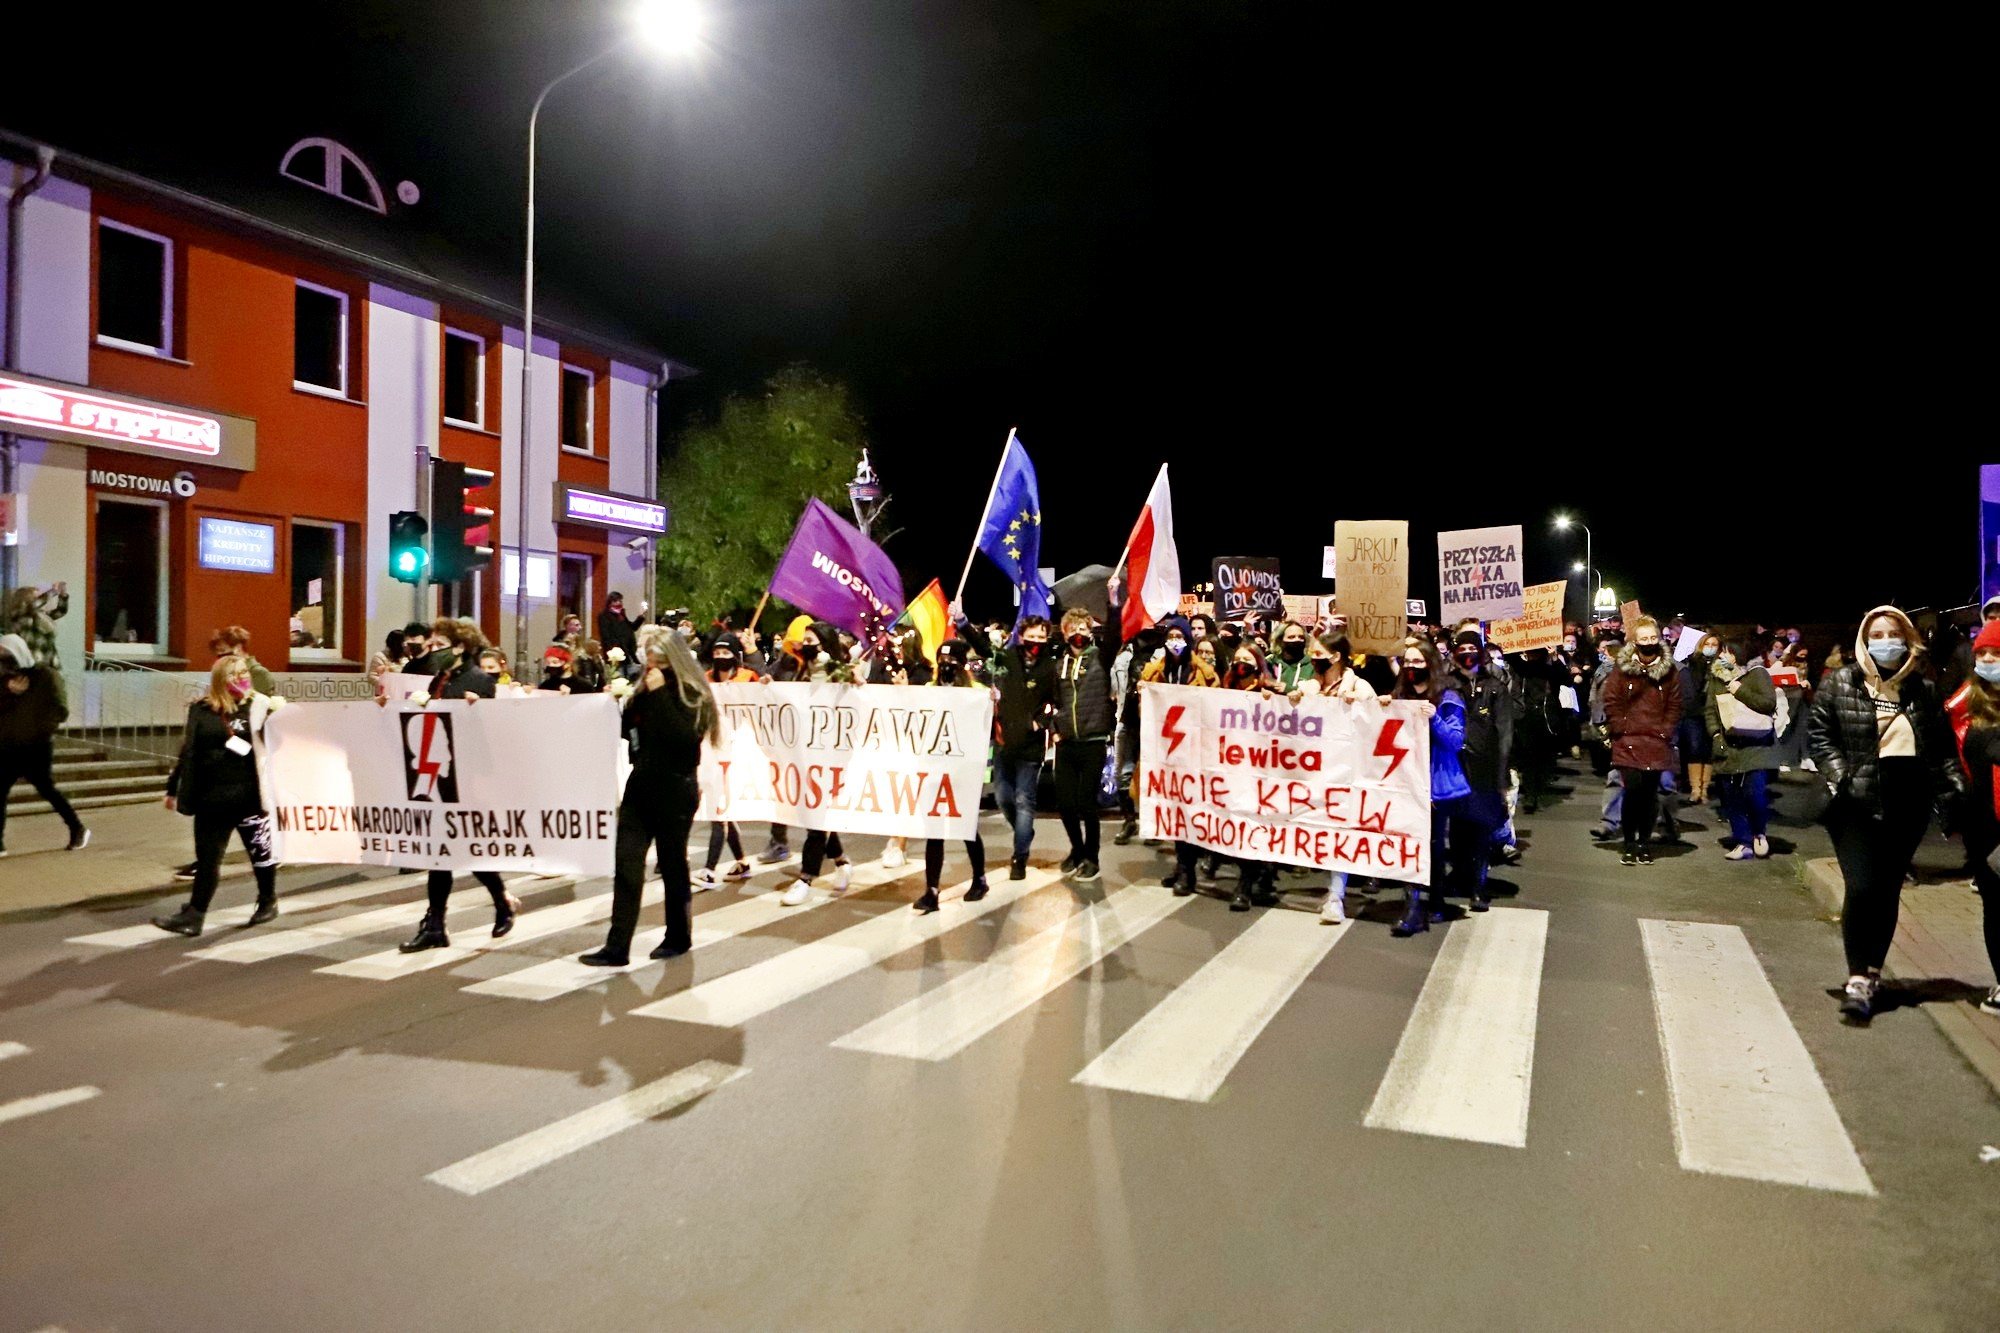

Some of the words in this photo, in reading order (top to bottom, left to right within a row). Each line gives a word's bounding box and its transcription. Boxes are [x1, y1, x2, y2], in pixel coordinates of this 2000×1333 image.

[91, 470, 172, 494] MOSTOWA
[174, 471, 196, 497] 6
[205, 553, 270, 568] HIPOTECZNE
[1347, 537, 1398, 562] JARKU!
[1443, 544, 1516, 568] PRZYSZŁA
[1218, 564, 1251, 590] QUO
[1251, 569, 1280, 590] VADIS
[1224, 590, 1280, 609] POLSKO?
[1360, 602, 1377, 616] TO
[1346, 615, 1402, 640] NDRZEJ!
[807, 705, 965, 757] PRAWA
[1219, 703, 1323, 737] młoda
[1219, 735, 1322, 772] lewica
[1147, 769, 1230, 808] MACIE
[1256, 779, 1391, 833] KREW
[277, 804, 432, 838] MIĘDZYNARODOWY
[446, 809, 527, 840] STRAJK
[541, 810, 613, 840] KOBIE
[361, 837, 451, 857] JELENIA
[470, 841, 536, 858] GÓRA
[1155, 805, 1189, 838] NA
[1295, 830, 1421, 873] RĘKACH
